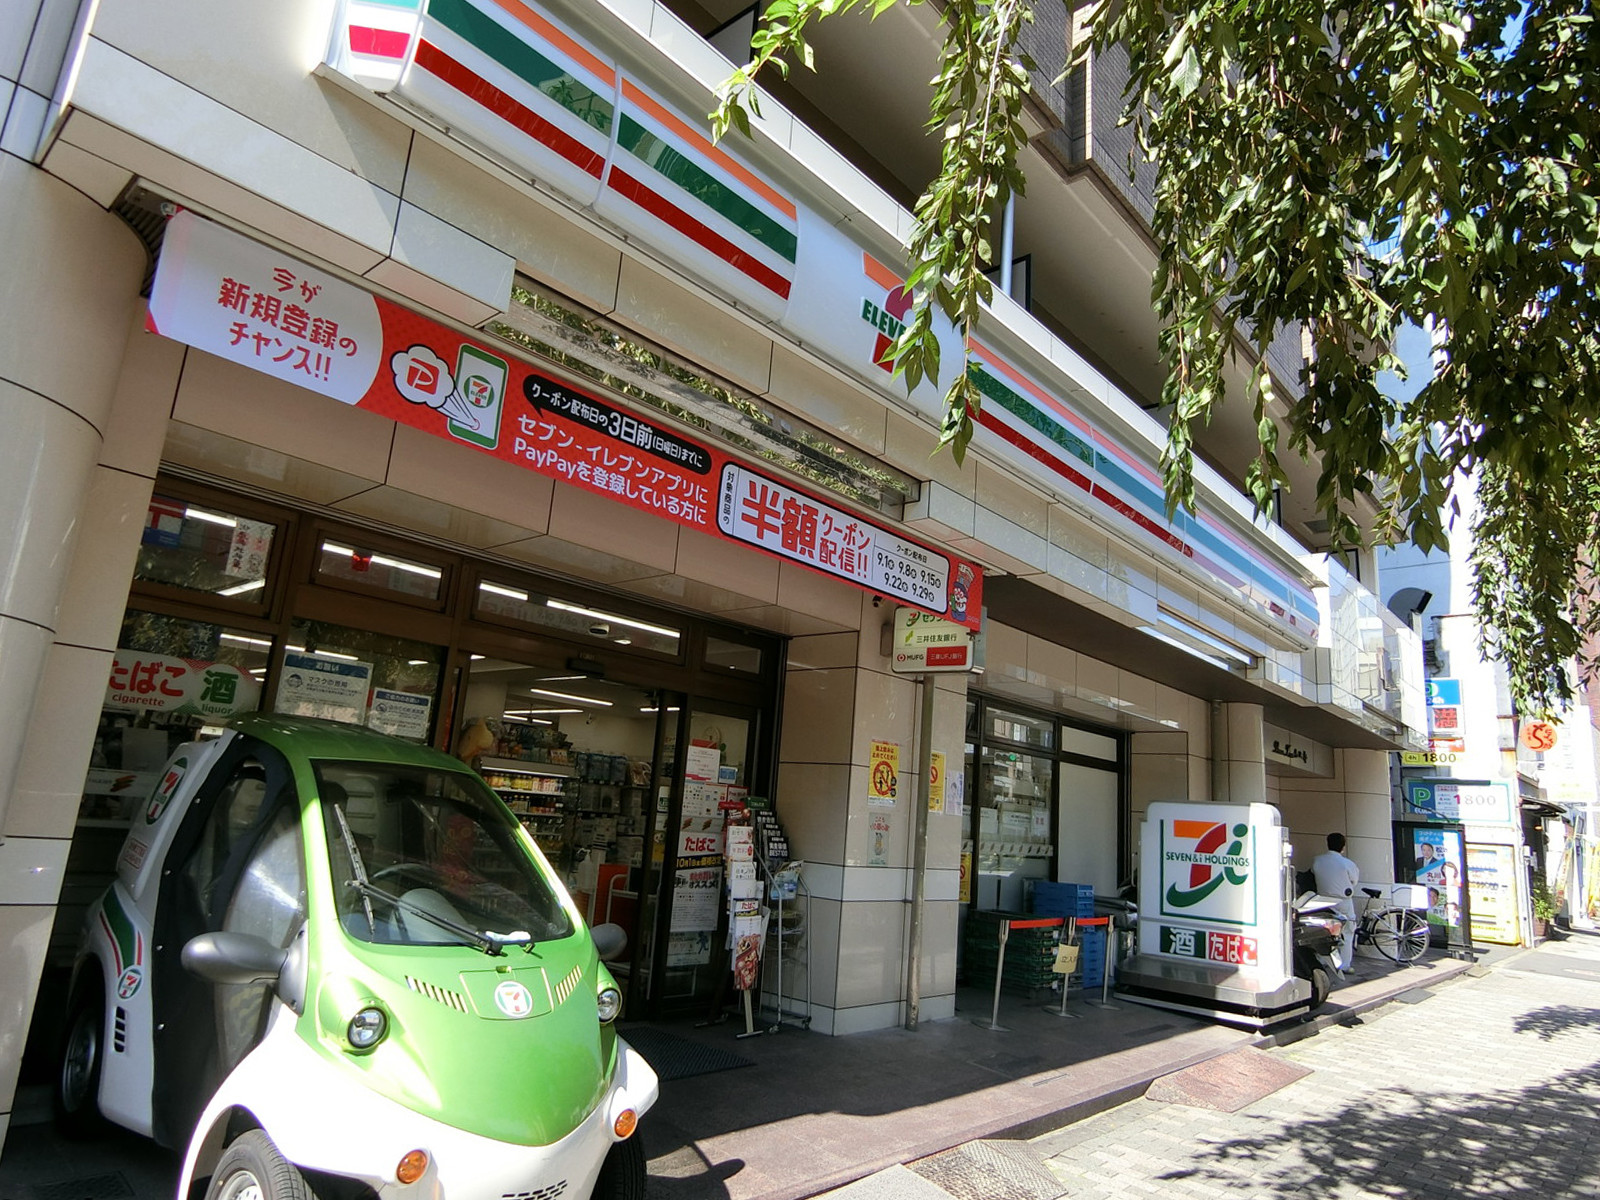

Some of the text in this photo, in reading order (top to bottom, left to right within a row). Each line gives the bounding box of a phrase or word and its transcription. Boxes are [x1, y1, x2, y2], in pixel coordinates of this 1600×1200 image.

[272, 267, 322, 303] 今が
[217, 277, 358, 357] 新規登録の
[861, 298, 907, 341] ELEV
[229, 321, 331, 382] チャンス!!
[514, 438, 707, 525] PayPayを登録している方に
[741, 480, 818, 558] 半額
[822, 512, 871, 552] クーポン
[819, 538, 868, 578] 配信!!
[916, 633, 957, 643] 三井住友銀行
[112, 693, 233, 714] cigarette liquor
[200, 670, 239, 705] 酒
[685, 837, 716, 852] たばこ
[1166, 851, 1249, 867] SEVEN&i HOLDINGS
[1170, 927, 1257, 965] 酒 たばこ
